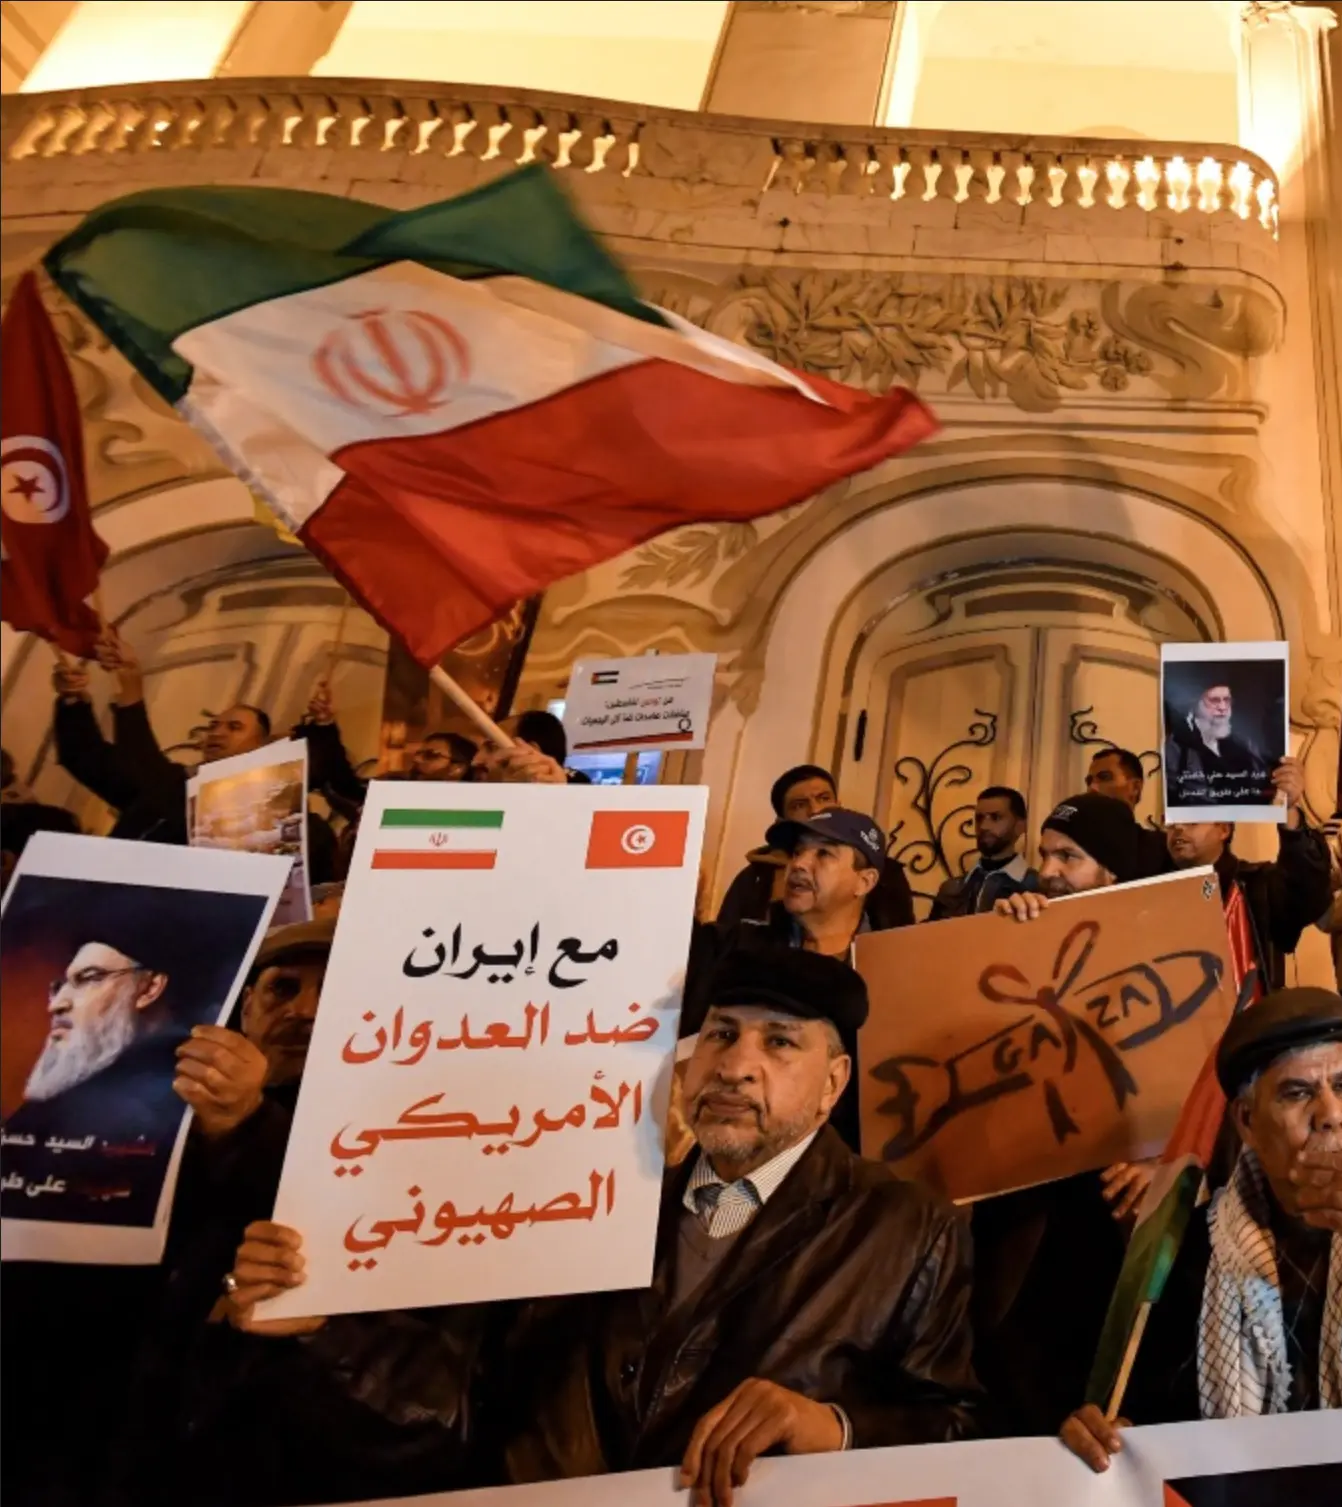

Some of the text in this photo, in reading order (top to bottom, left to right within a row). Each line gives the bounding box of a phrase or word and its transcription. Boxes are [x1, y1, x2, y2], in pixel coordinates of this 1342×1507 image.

[402, 921, 619, 989] مع إيران
[341, 1000, 660, 1066] ضد العدوان
[44, 1134, 96, 1155] السيد
[329, 1070, 643, 1178] الأمريكي
[343, 1167, 615, 1273] الصهيوني
